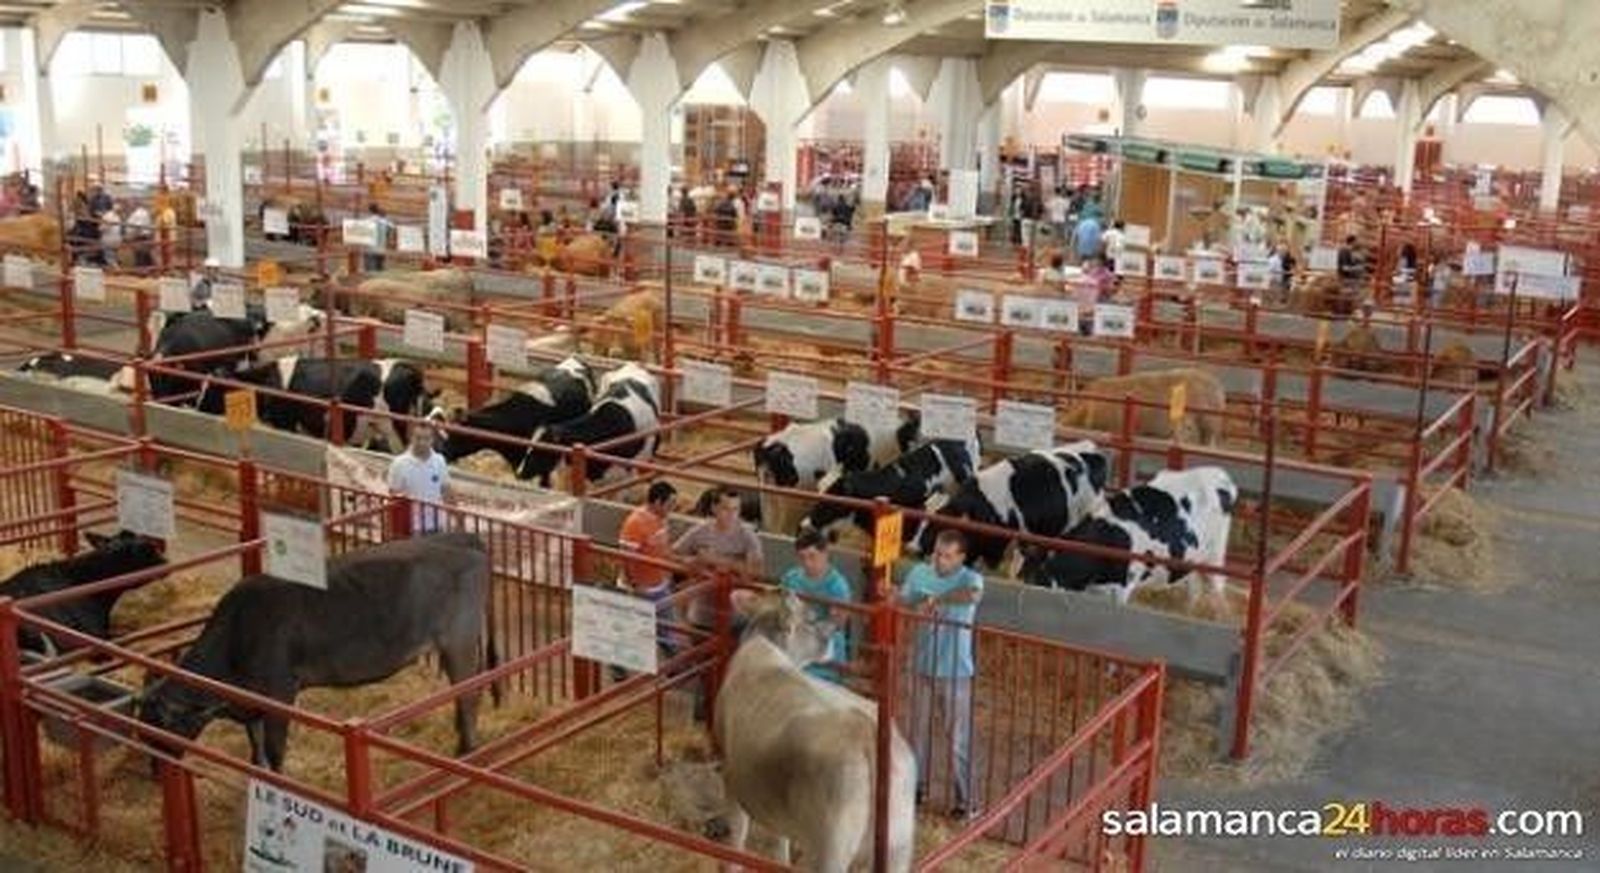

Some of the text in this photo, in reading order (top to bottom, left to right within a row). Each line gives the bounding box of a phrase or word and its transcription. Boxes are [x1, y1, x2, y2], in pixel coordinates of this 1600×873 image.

[1270, 14, 1337, 31] Salamanca
[254, 785, 277, 806] LE
[282, 798, 323, 823] SUD
[352, 827, 380, 847] LA
[386, 838, 467, 873] BRUNE
